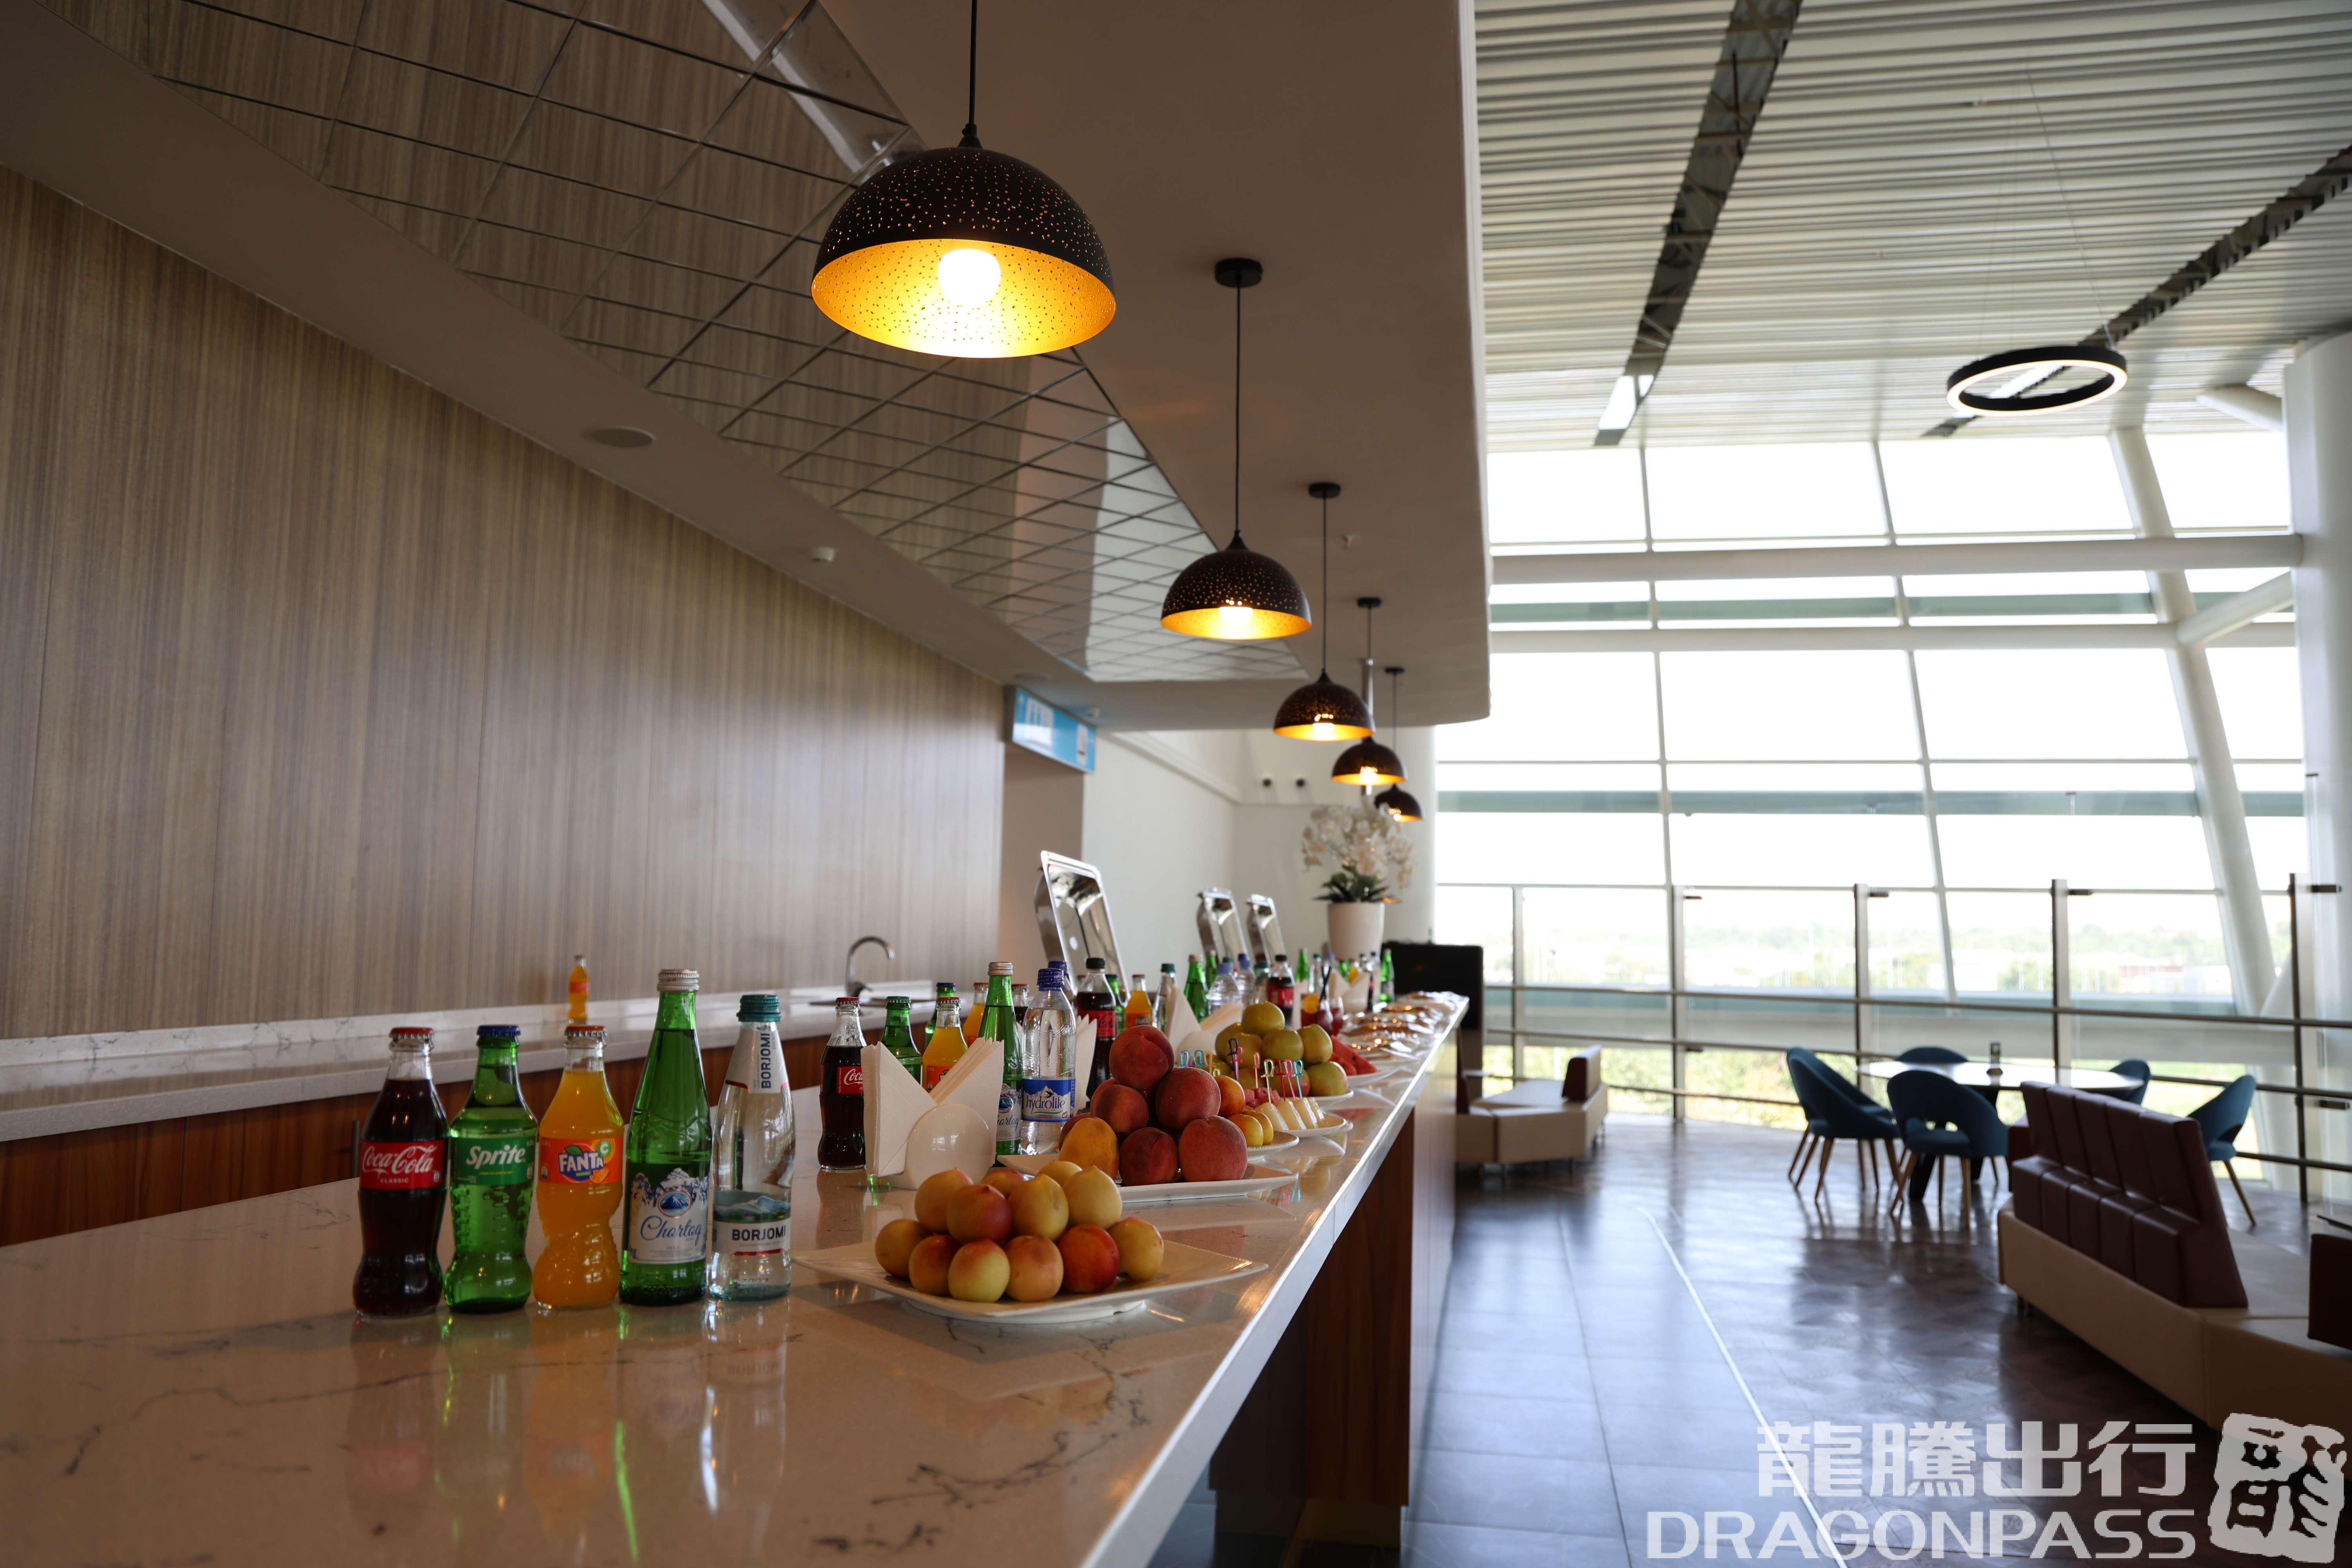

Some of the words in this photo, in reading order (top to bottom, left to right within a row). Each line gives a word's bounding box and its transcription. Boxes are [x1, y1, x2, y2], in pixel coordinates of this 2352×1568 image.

[760, 1033, 771, 1088] BORJOMI
[362, 1145, 438, 1175] Coca-Cola
[466, 1144, 526, 1170] Sprite
[559, 1152, 604, 1172] FANTA
[732, 1225, 786, 1241] BORJOMI
